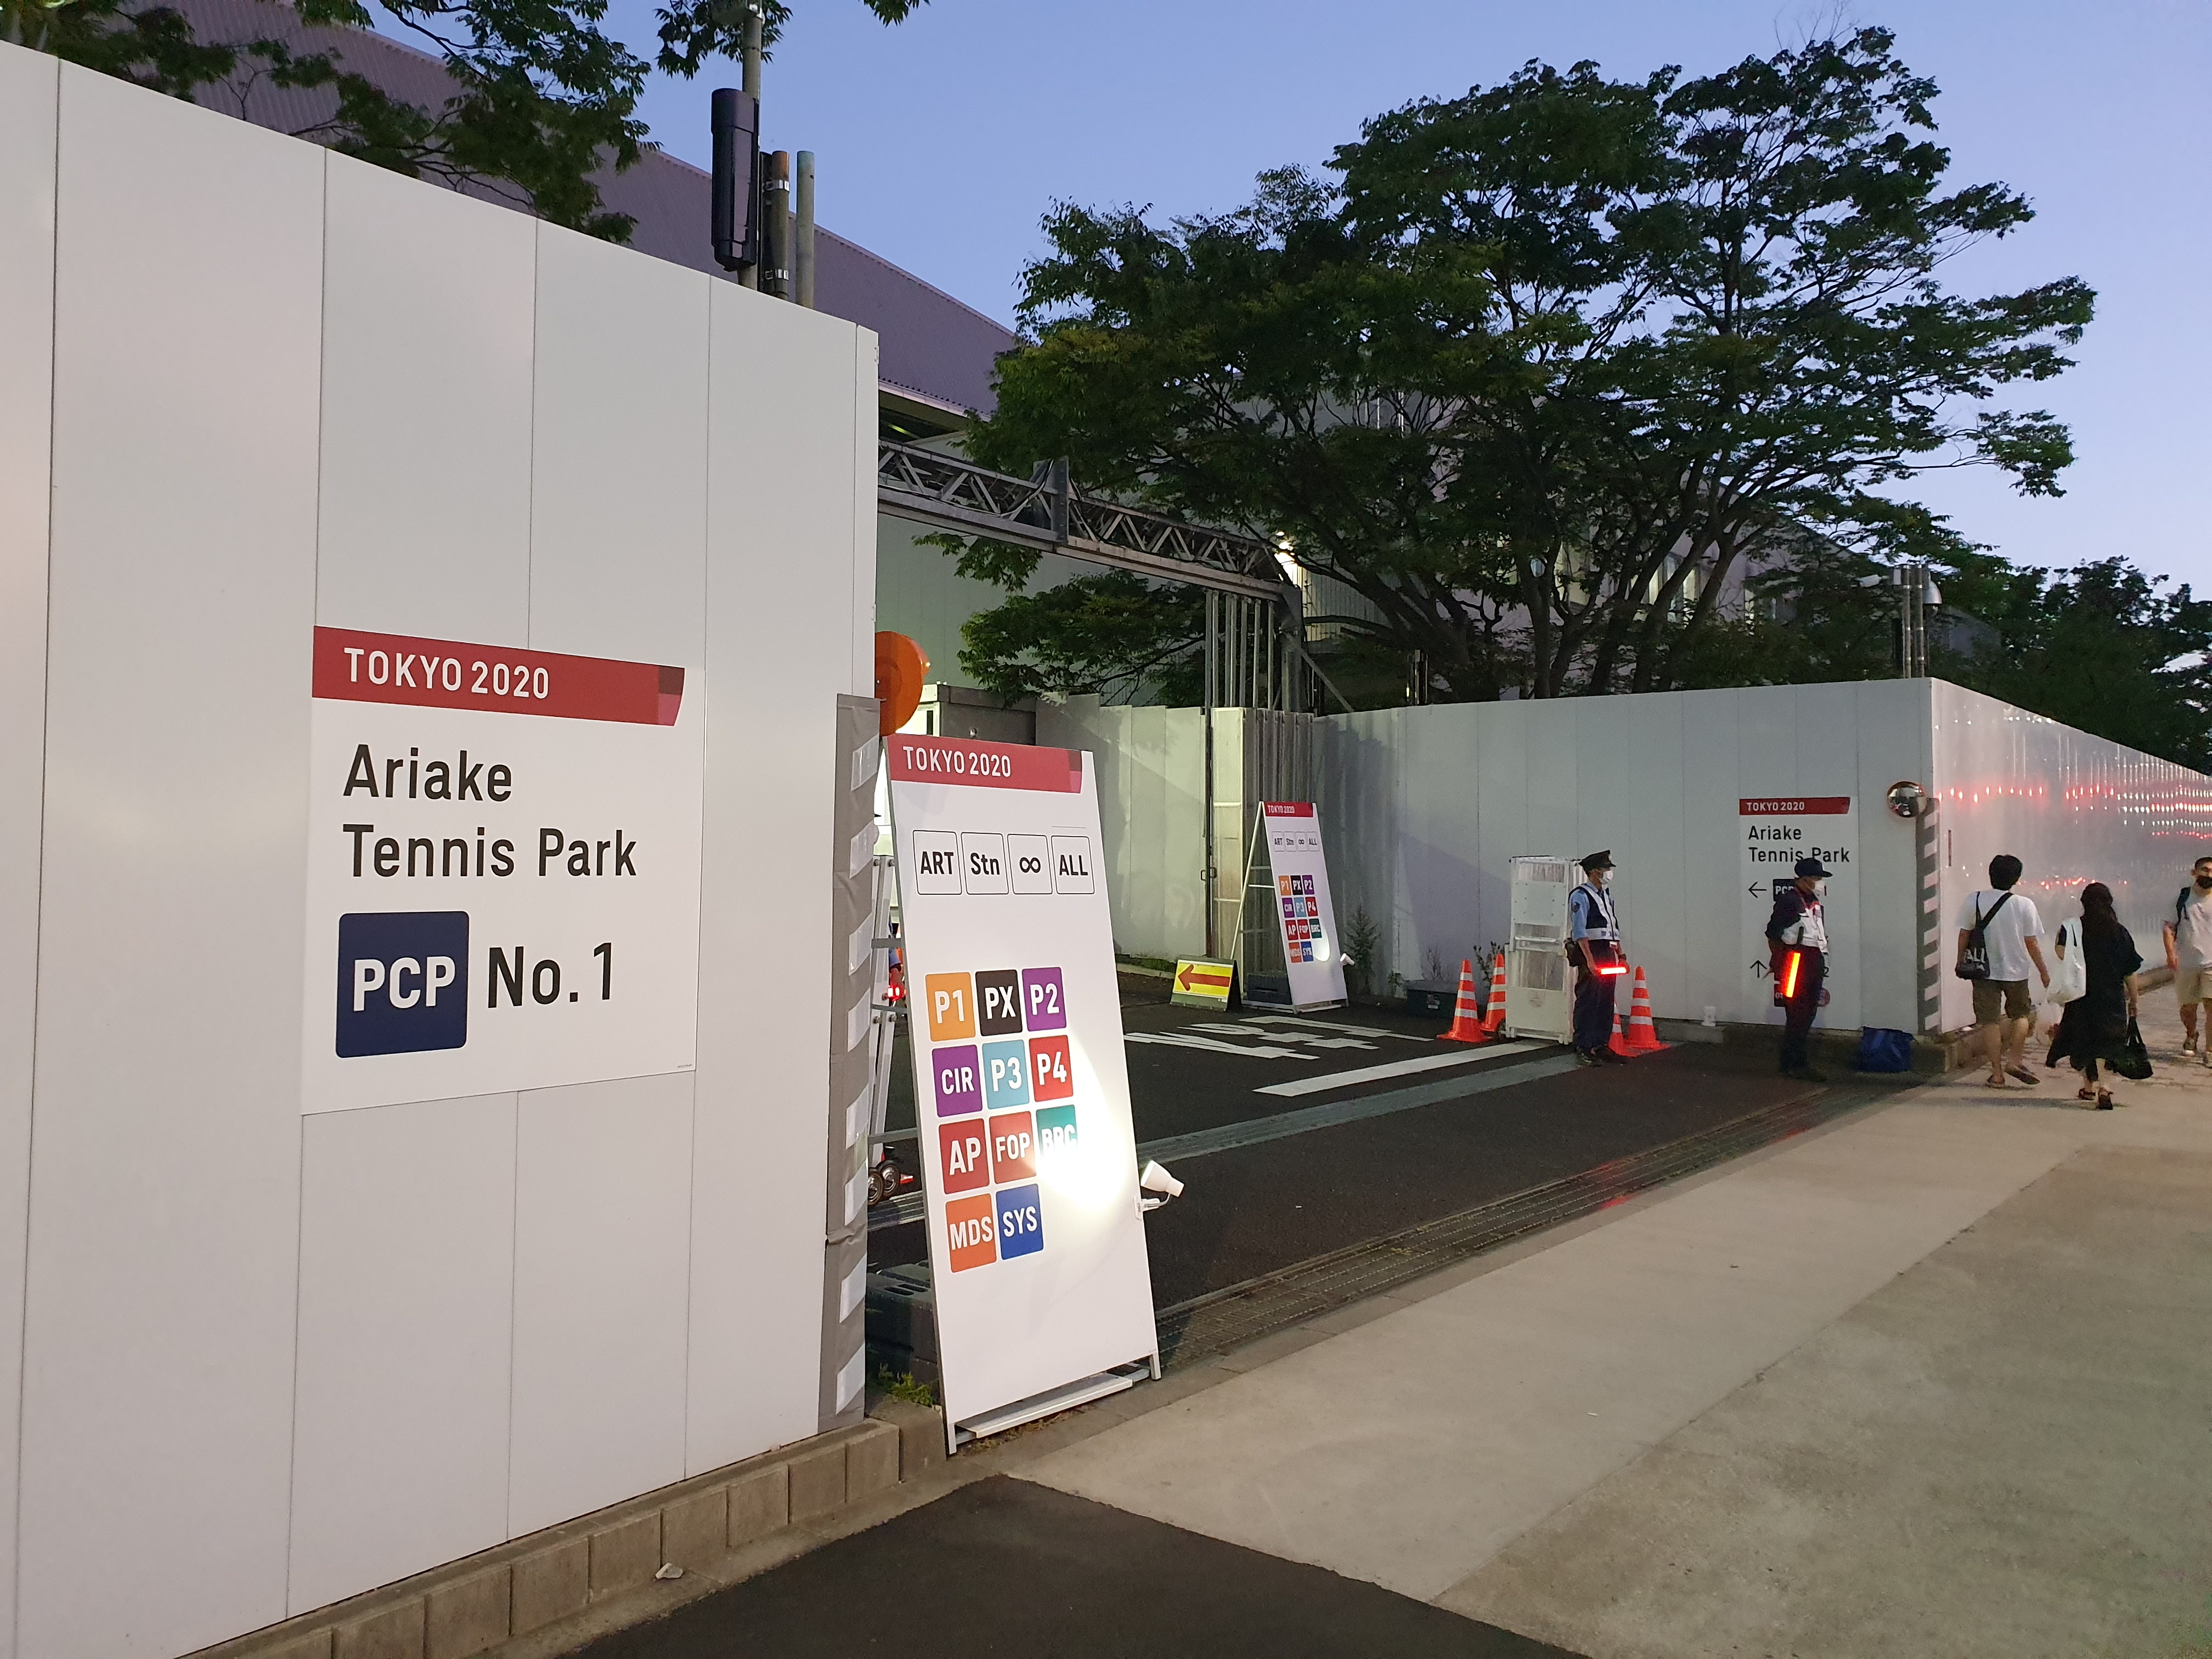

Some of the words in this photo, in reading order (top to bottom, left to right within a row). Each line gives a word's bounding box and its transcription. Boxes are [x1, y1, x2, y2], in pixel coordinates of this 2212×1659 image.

[343, 647, 462, 691] TOKYO
[471, 661, 549, 699] 2020
[343, 743, 512, 802] Ariake
[902, 746, 964, 774] TOKYO
[969, 752, 1012, 777] 2020
[1267, 804, 1284, 813] TOKYO
[1284, 805, 1295, 814] 2020
[1746, 802, 1779, 811] TOKYO
[1780, 802, 1805, 811] 2020
[1748, 825, 1802, 840] Ariake
[343, 824, 515, 877] Tennis
[539, 827, 637, 877] Park
[920, 851, 954, 875] ART
[970, 852, 1001, 876] Stn
[1059, 854, 1088, 876] ALL
[1748, 847, 1804, 862] Tennis
[1812, 847, 1850, 862] Park
[1280, 880, 1289, 891] P1
[1293, 880, 1301, 890] PX
[1304, 879, 1313, 890] P2
[1296, 902, 1305, 912] P3
[1307, 901, 1316, 912] P4
[1288, 924, 1296, 935] AP
[1302, 947, 1312, 956] SYS
[353, 956, 456, 1012] PCP
[934, 989, 965, 1024] P1
[984, 985, 1017, 1020] PX
[1029, 983, 1060, 1016] P2
[941, 1066, 975, 1095] CIR
[990, 1056, 1023, 1092] P3
[1036, 1051, 1068, 1086] P4
[949, 1137, 981, 1176] AP
[995, 1132, 1031, 1163] FOP
[950, 1215, 994, 1250] MDS
[1002, 1205, 1037, 1238] SYS
